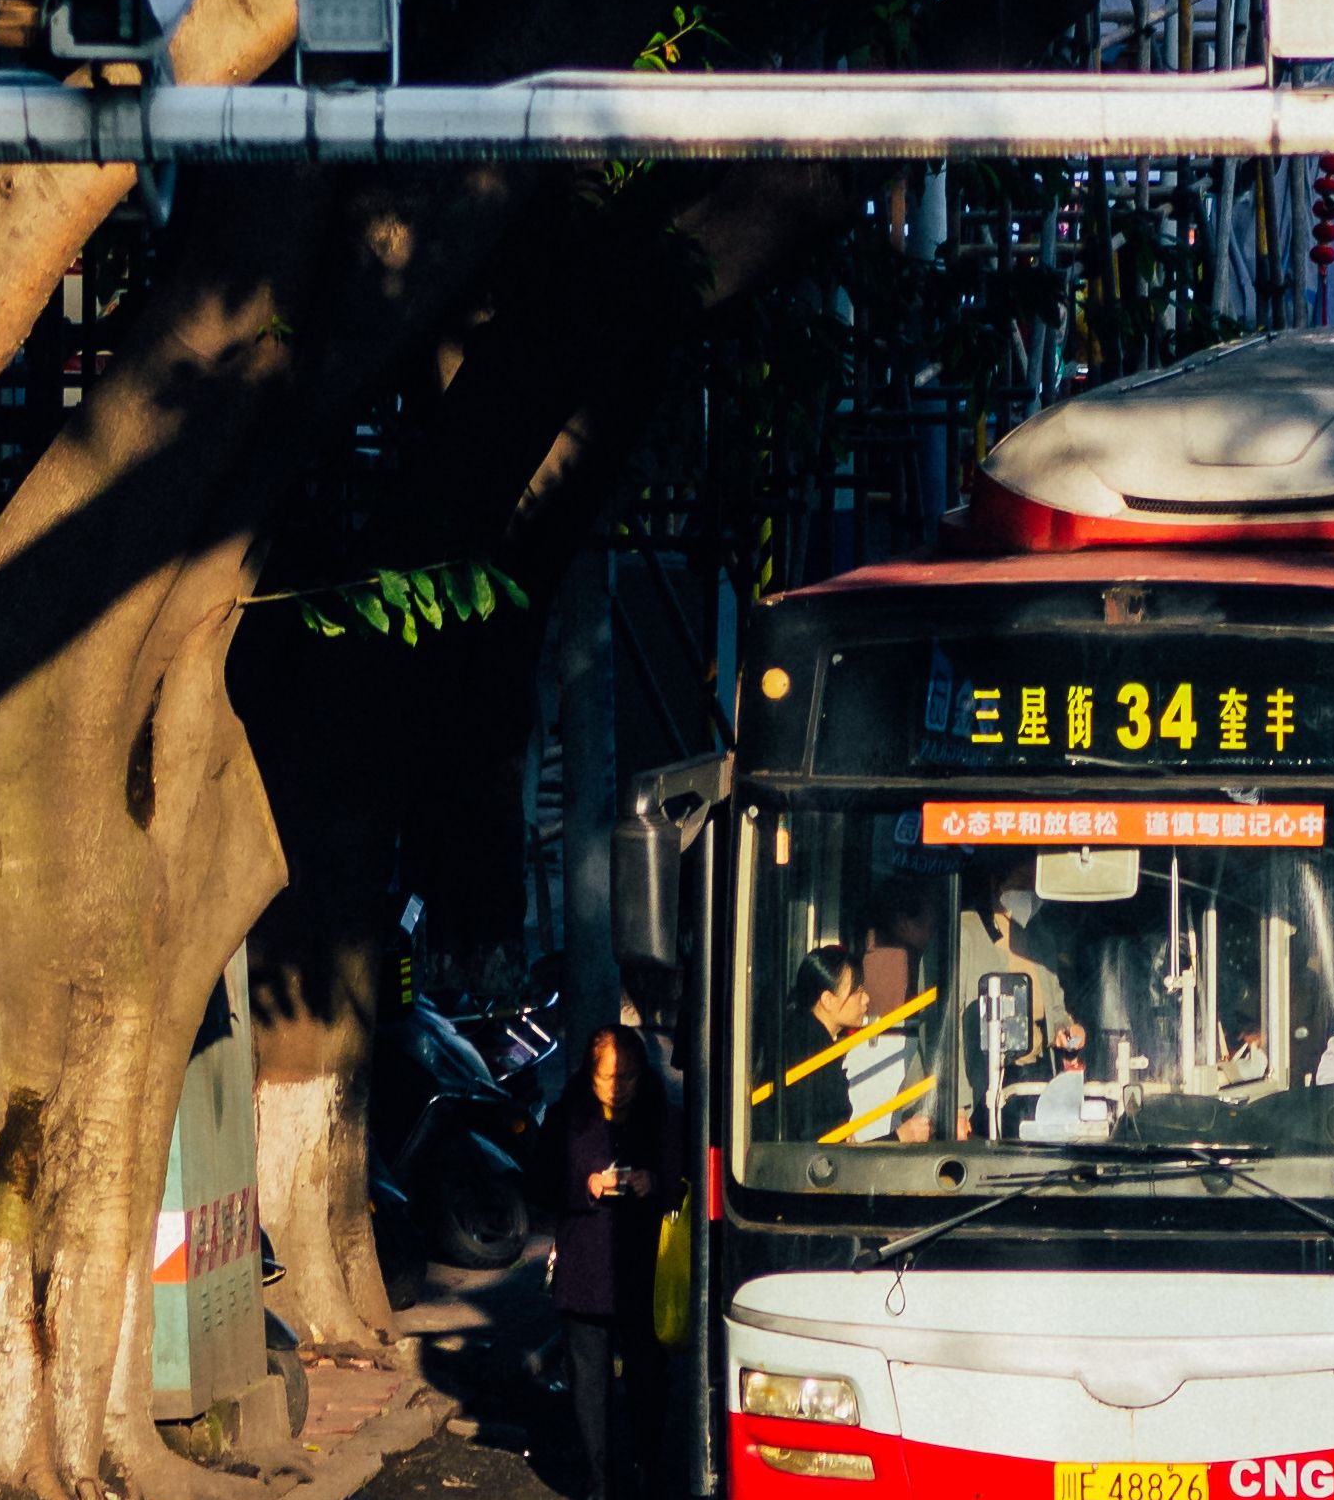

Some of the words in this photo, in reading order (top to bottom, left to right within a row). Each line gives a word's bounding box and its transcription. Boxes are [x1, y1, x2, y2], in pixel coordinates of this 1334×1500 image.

[971, 686, 1094, 749] 三星街
[1115, 682, 1198, 750] 34
[1219, 687, 1295, 751] 奎丰
[942, 810, 1119, 837] 心态平和放轻松
[1145, 811, 1324, 838] 谨慎驾驶记心中
[1229, 1460, 1334, 1498] CNG
